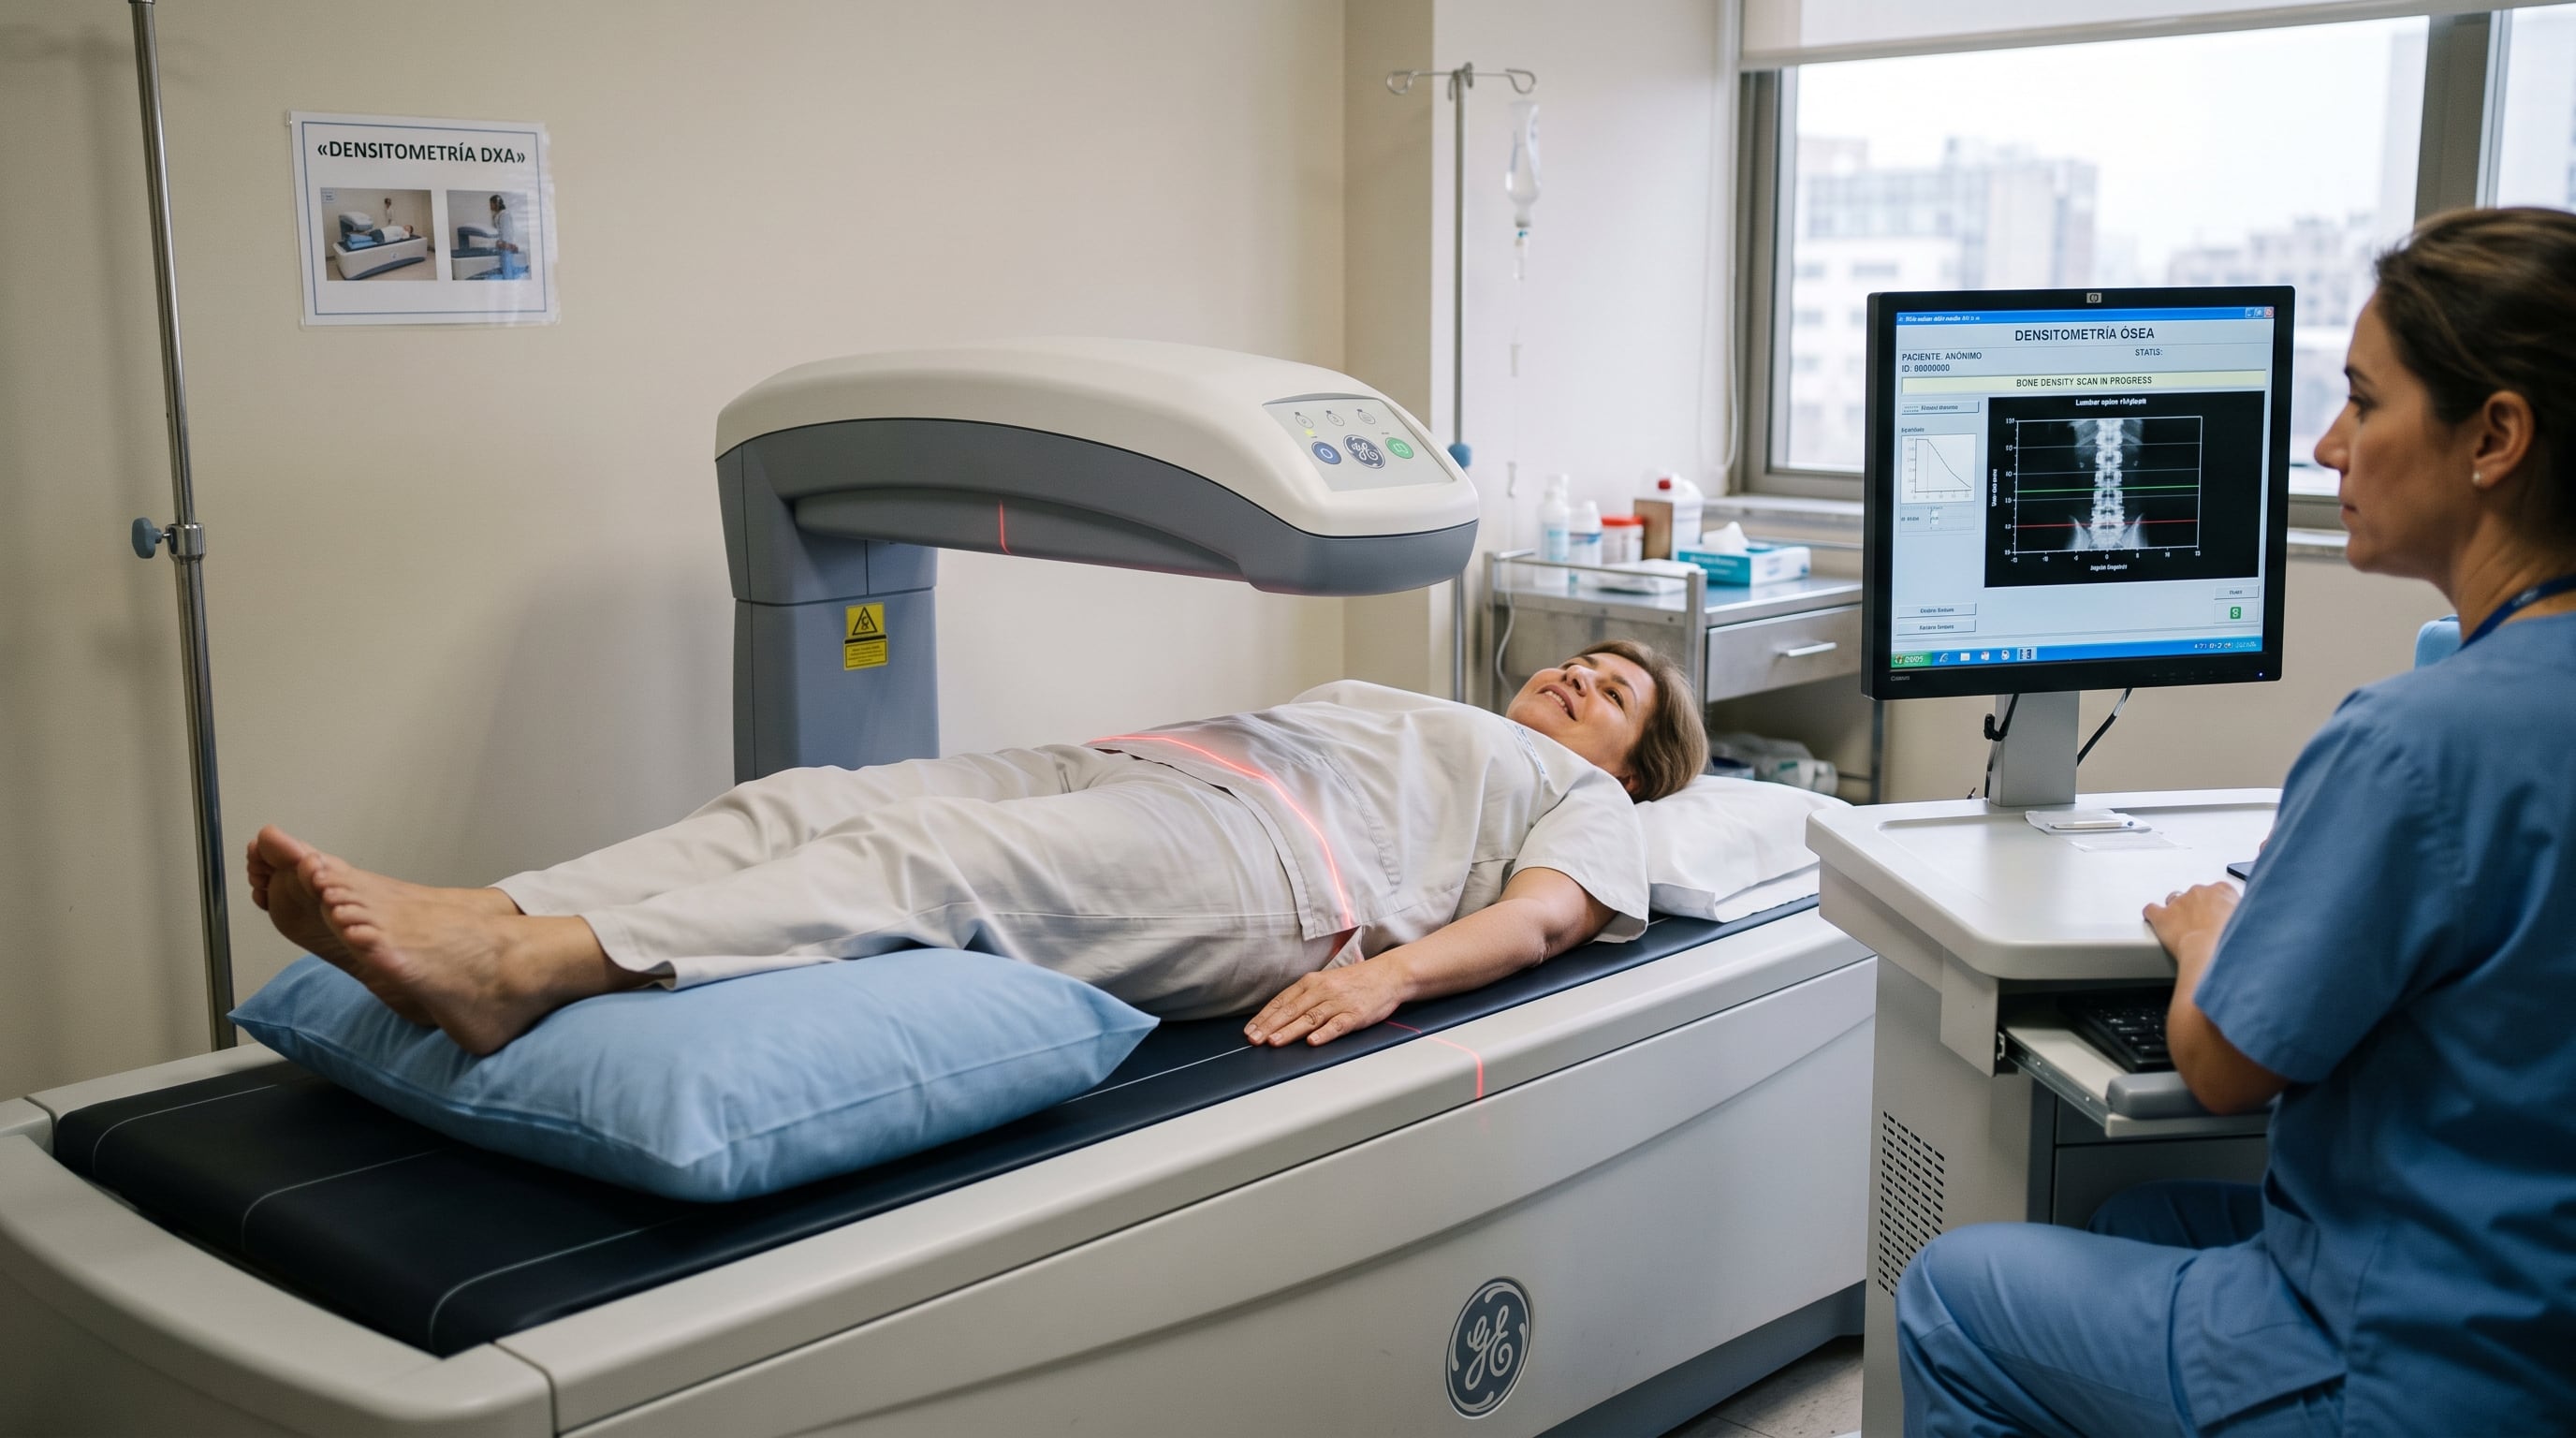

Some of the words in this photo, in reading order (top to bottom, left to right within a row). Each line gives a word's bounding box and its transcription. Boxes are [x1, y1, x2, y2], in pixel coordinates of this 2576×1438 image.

[317, 140, 476, 162] «DENSITOMETRÍA
[481, 147, 525, 163] DXA»
[2014, 326, 2117, 341] DENSITOMETRÍA
[2120, 326, 2155, 339] ÓSEA
[1945, 351, 1982, 360] ANÓNIMO
[2076, 377, 2098, 386] SCAN
[2110, 376, 2152, 385] PROGRESS
